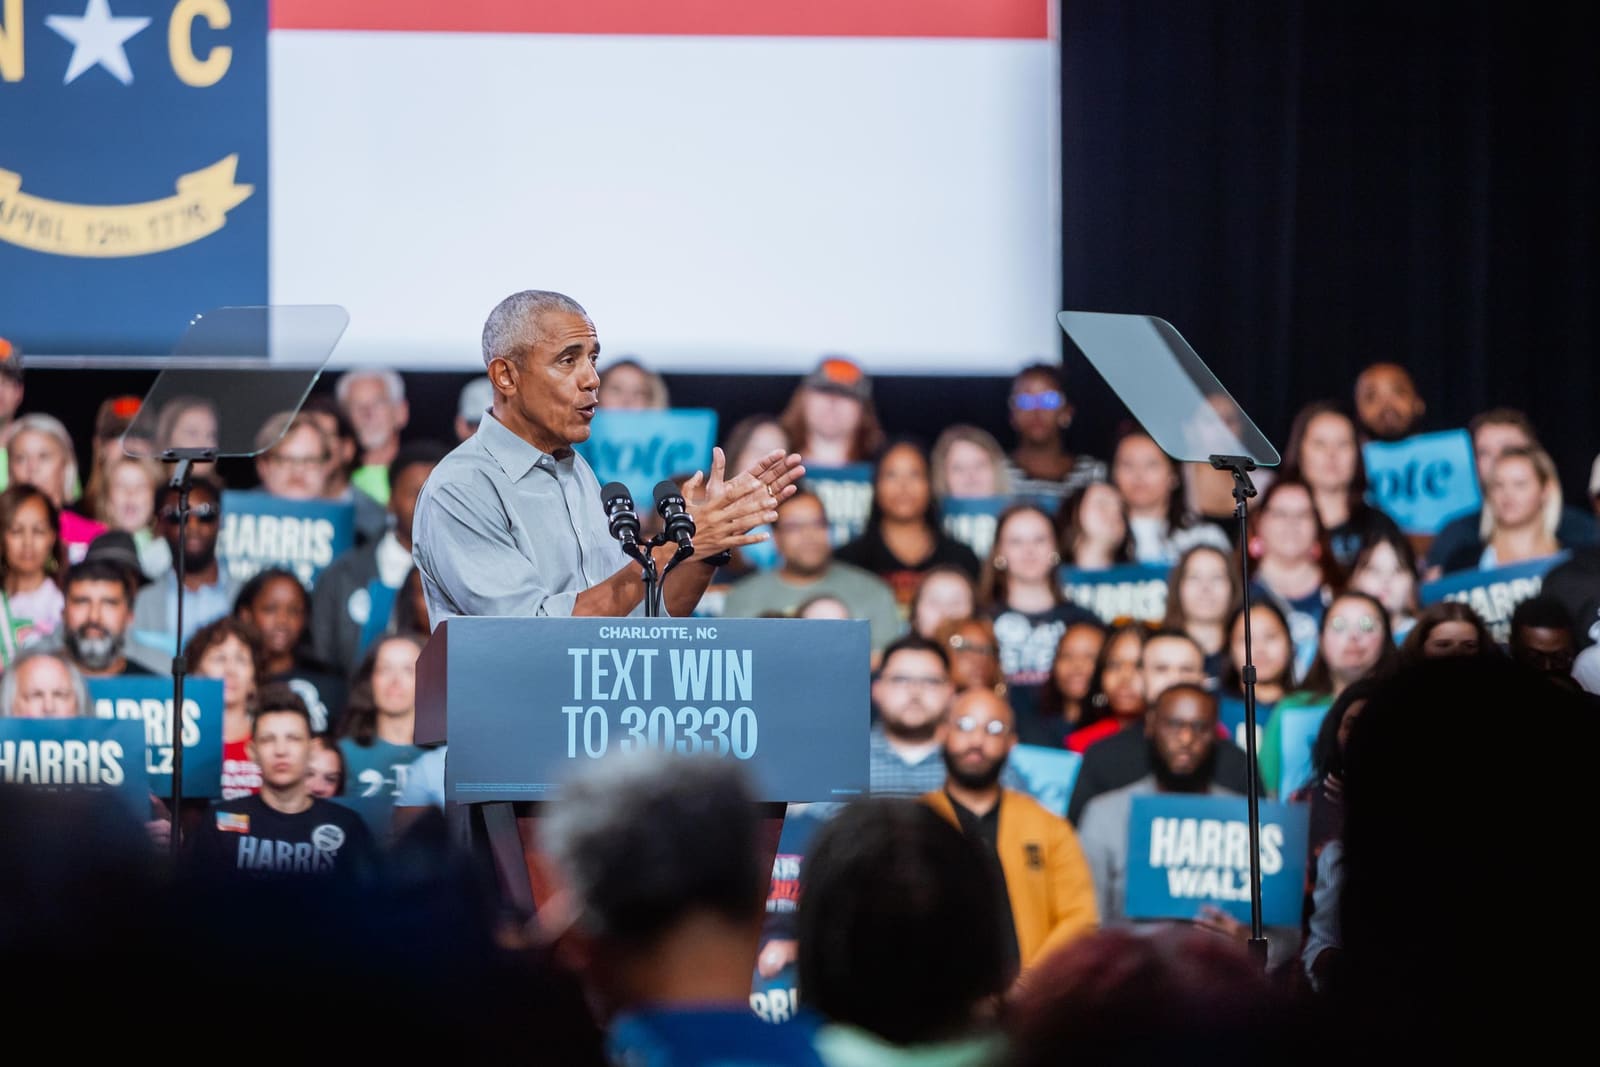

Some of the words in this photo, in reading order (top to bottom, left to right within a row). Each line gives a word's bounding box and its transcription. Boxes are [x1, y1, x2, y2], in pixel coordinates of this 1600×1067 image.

[1371, 457, 1453, 500] ote
[599, 626, 693, 641] CHARLOTTE,
[697, 628, 718, 640] NC
[568, 648, 659, 701] TEXT
[669, 649, 752, 701] WIN
[561, 705, 609, 759] TO
[620, 705, 758, 760] 30330
[1150, 817, 1284, 876] HARRS
